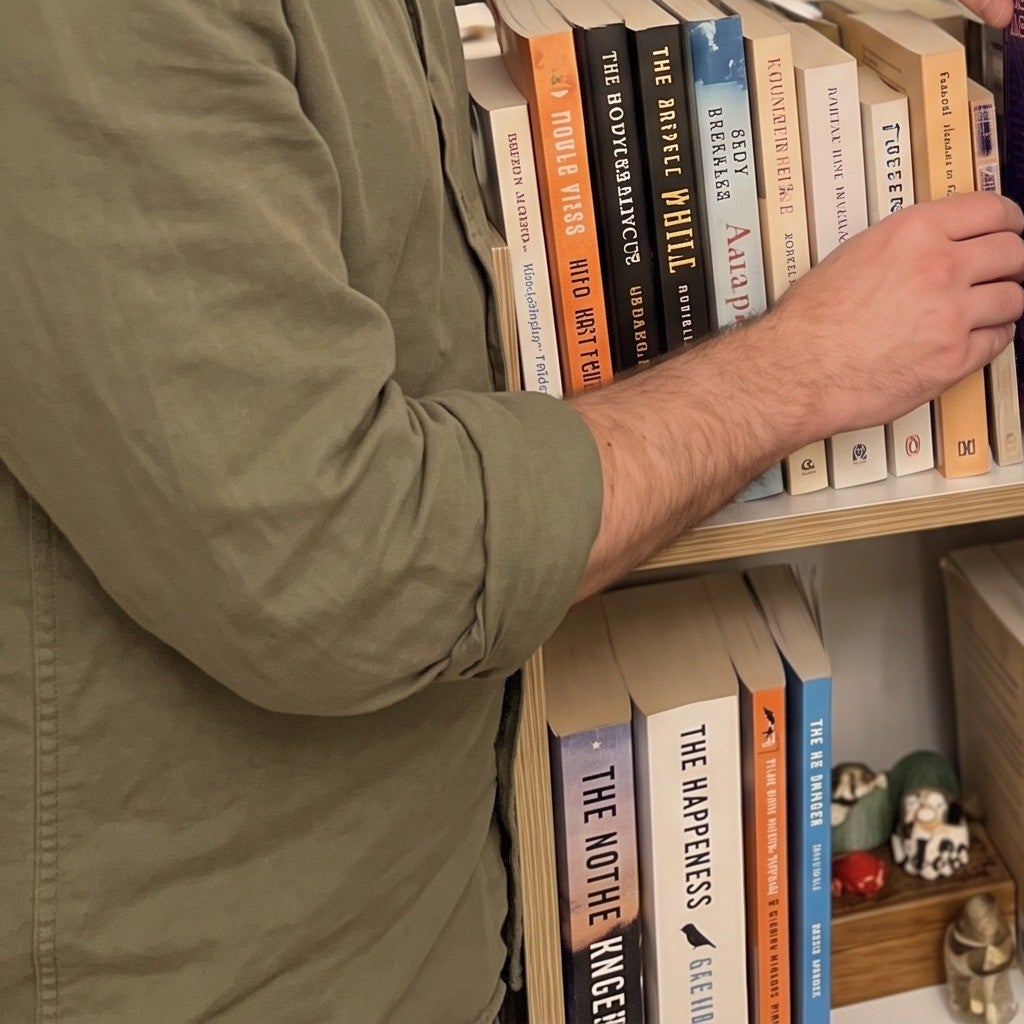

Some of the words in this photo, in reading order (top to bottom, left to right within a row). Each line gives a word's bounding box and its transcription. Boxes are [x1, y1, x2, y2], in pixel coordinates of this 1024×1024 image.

[601, 50, 620, 85] THE
[651, 46, 672, 85] THE
[679, 724, 707, 771] THE
[810, 718, 822, 745] THE
[580, 765, 617, 823] THE
[681, 777, 713, 909] HAPPENESS
[583, 831, 622, 926] NOTHE
